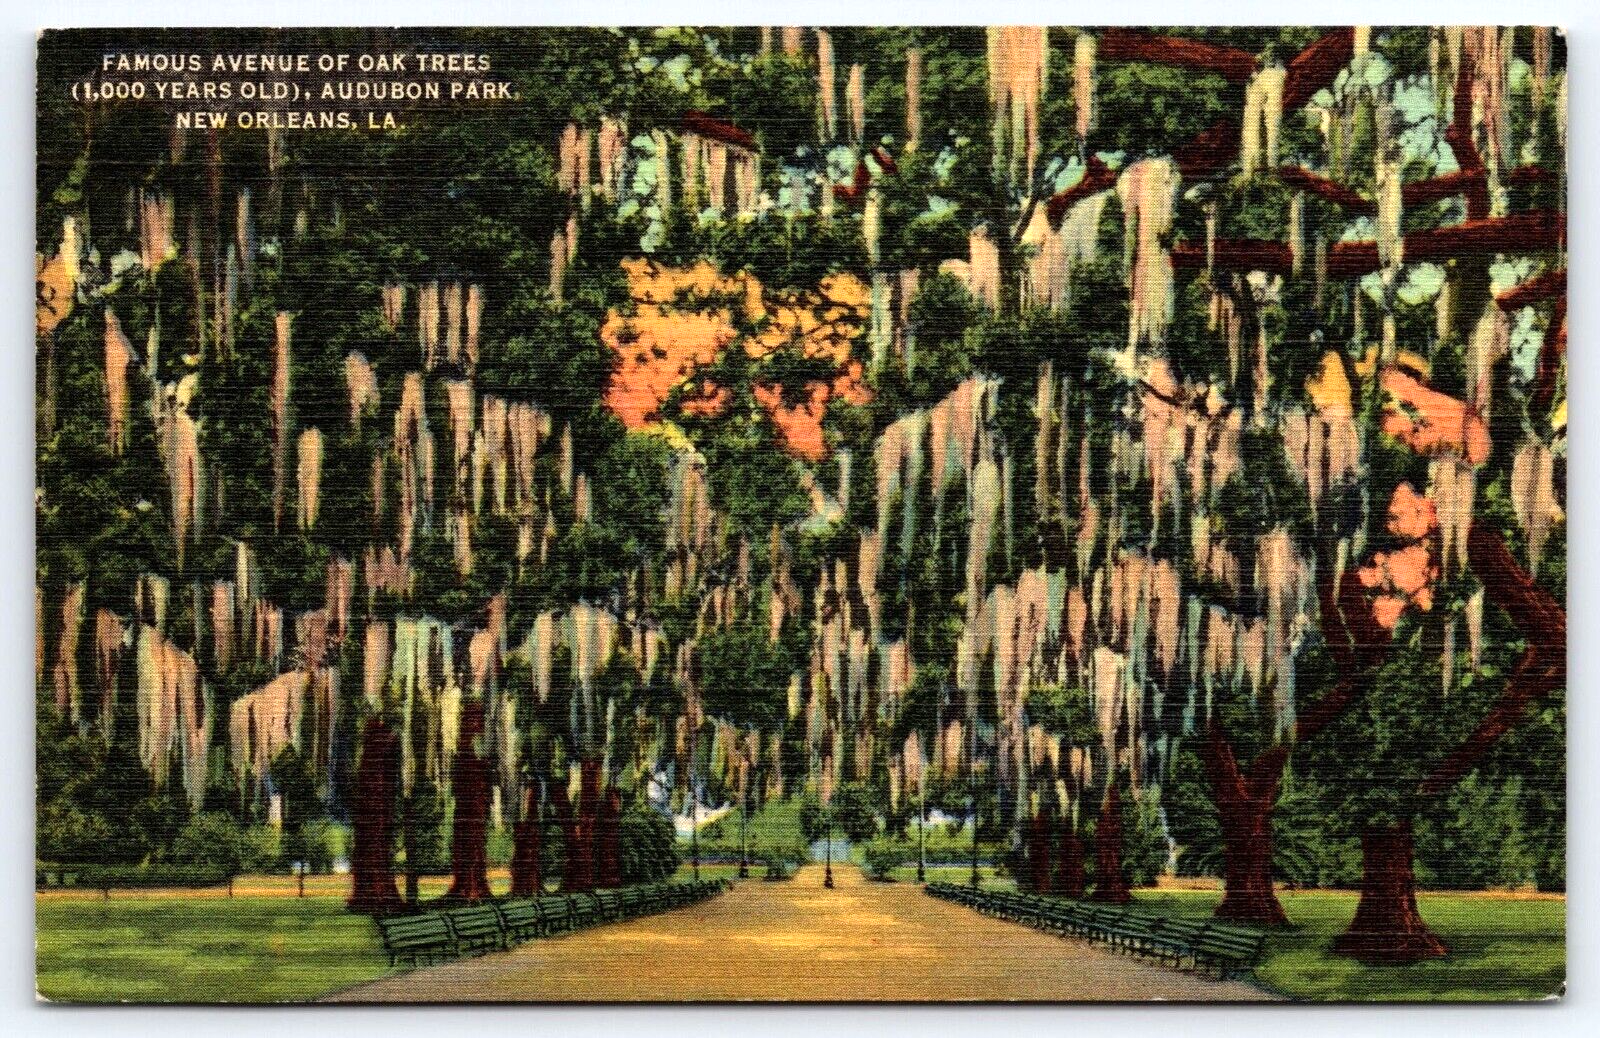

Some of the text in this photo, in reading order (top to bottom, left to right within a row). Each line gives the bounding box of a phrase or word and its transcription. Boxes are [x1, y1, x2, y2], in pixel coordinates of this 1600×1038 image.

[103, 53, 491, 73] FAMOUS AVENUE OF OAK TREES
[71, 81, 146, 102] (1,000
[153, 81, 232, 100] YEARS
[240, 81, 311, 102] OLD),
[320, 81, 439, 100] AUDUBON
[176, 111, 406, 130] NEW ORLEANS, LA.
